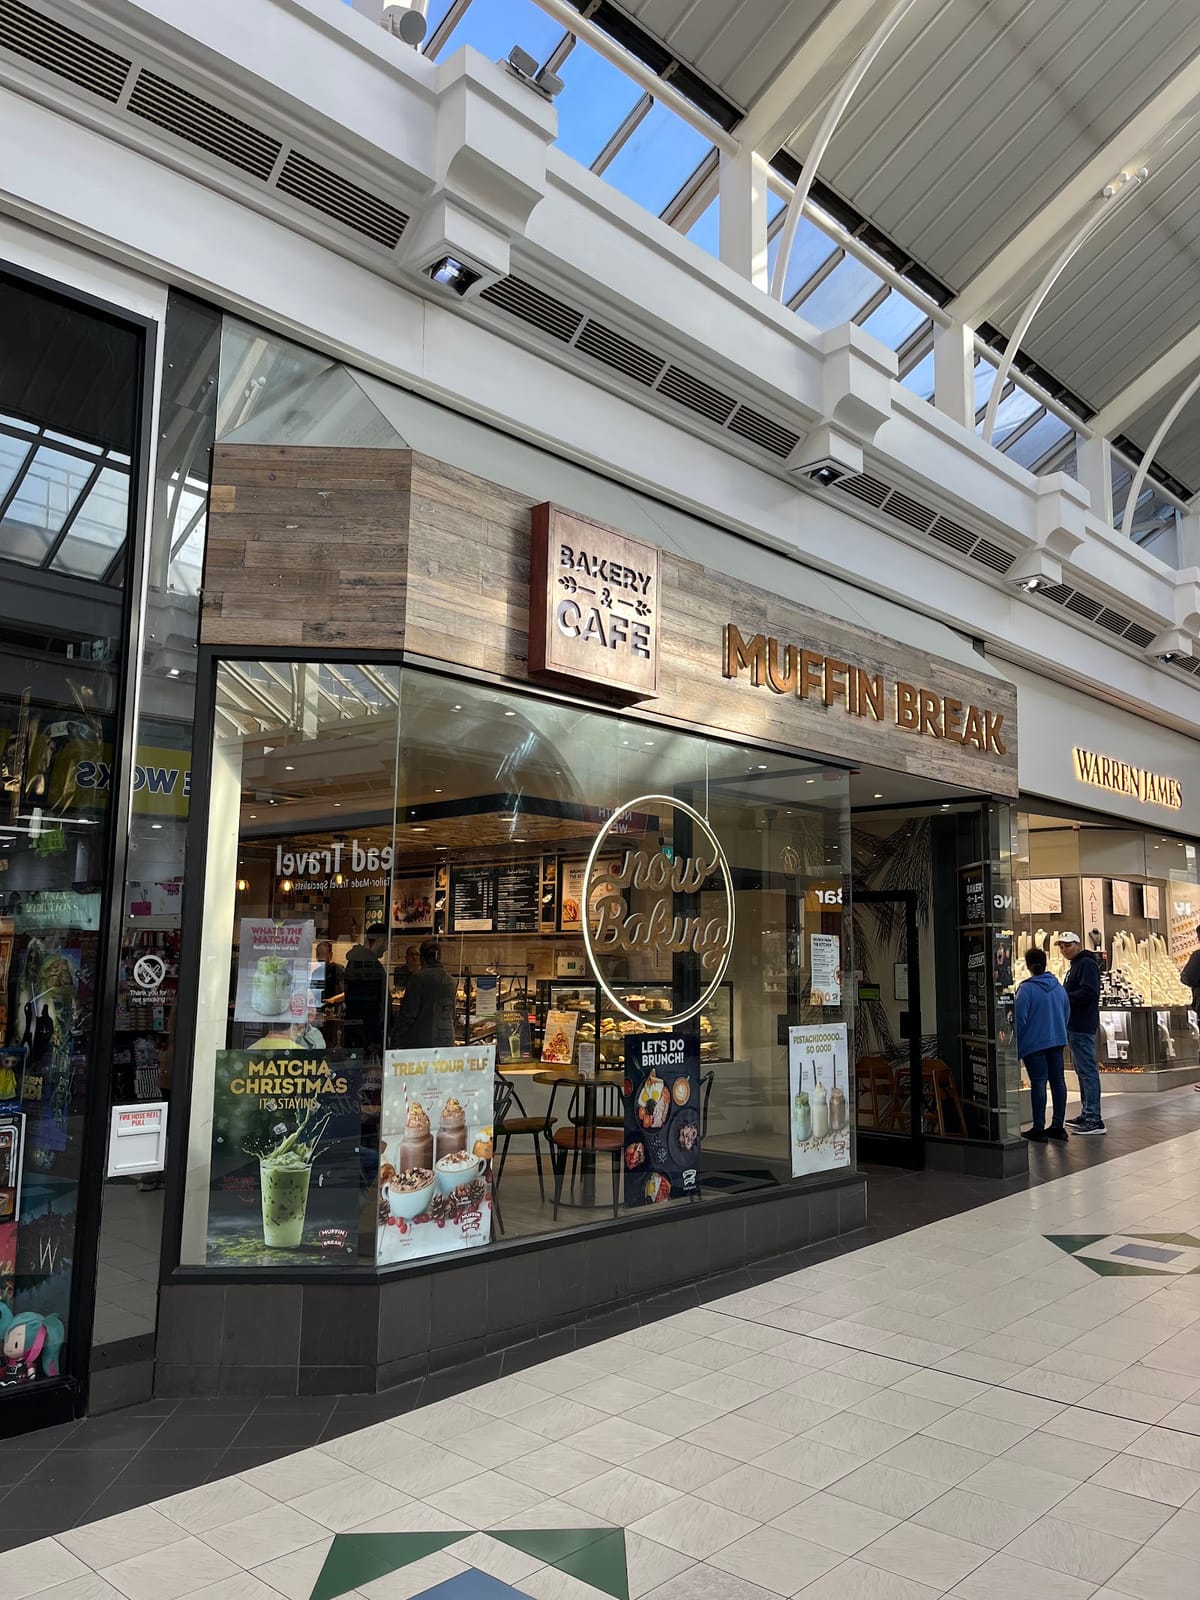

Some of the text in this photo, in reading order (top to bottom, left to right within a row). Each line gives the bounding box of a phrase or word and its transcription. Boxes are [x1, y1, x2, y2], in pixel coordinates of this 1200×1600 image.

[560, 544, 652, 596] BAKERY
[600, 587, 613, 609] &
[556, 599, 651, 660] CAFE
[722, 623, 1006, 756] MUFFIN BREAK
[1074, 747, 1183, 809] WARREN JAMES
[1088, 880, 1098, 923] SALE
[592, 896, 728, 969] Baking
[641, 1038, 685, 1054] LET'S DO
[247, 1059, 332, 1077] MATCHA
[392, 1061, 430, 1078] TREAT
[431, 1059, 465, 1075] YOUR
[641, 1051, 685, 1067] BRUNCH!
[230, 1078, 348, 1096] CHRISTMAS
[119, 1110, 160, 1121] FIRE HOSE REEL
[131, 1119, 145, 1127] PULL
